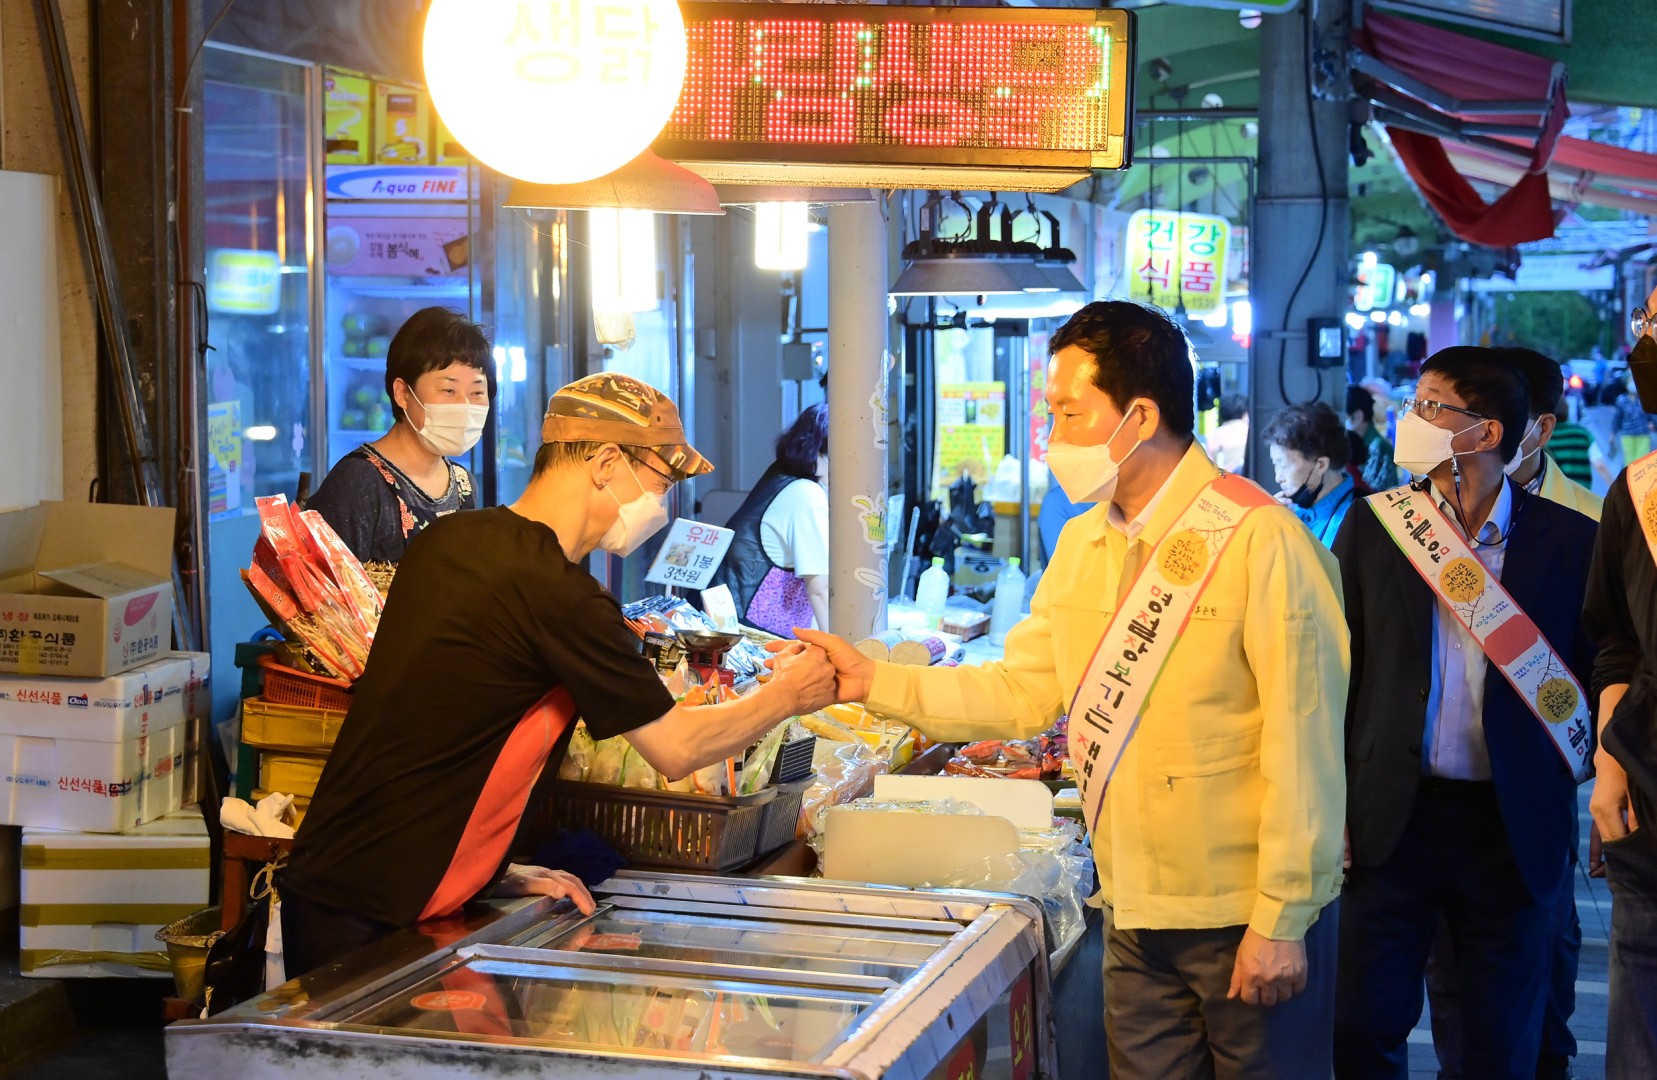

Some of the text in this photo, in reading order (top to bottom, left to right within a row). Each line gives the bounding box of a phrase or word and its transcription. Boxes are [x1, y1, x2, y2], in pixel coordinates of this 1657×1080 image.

[504, 0, 660, 87] 생닭
[372, 180, 457, 194] Aqua FINE
[1143, 221, 1221, 256] 건강
[1138, 257, 1215, 293] 식품
[686, 526, 719, 546] 유과
[693, 554, 713, 569] 1봉
[664, 566, 701, 583] 3천원
[16, 689, 62, 706] 신선식품
